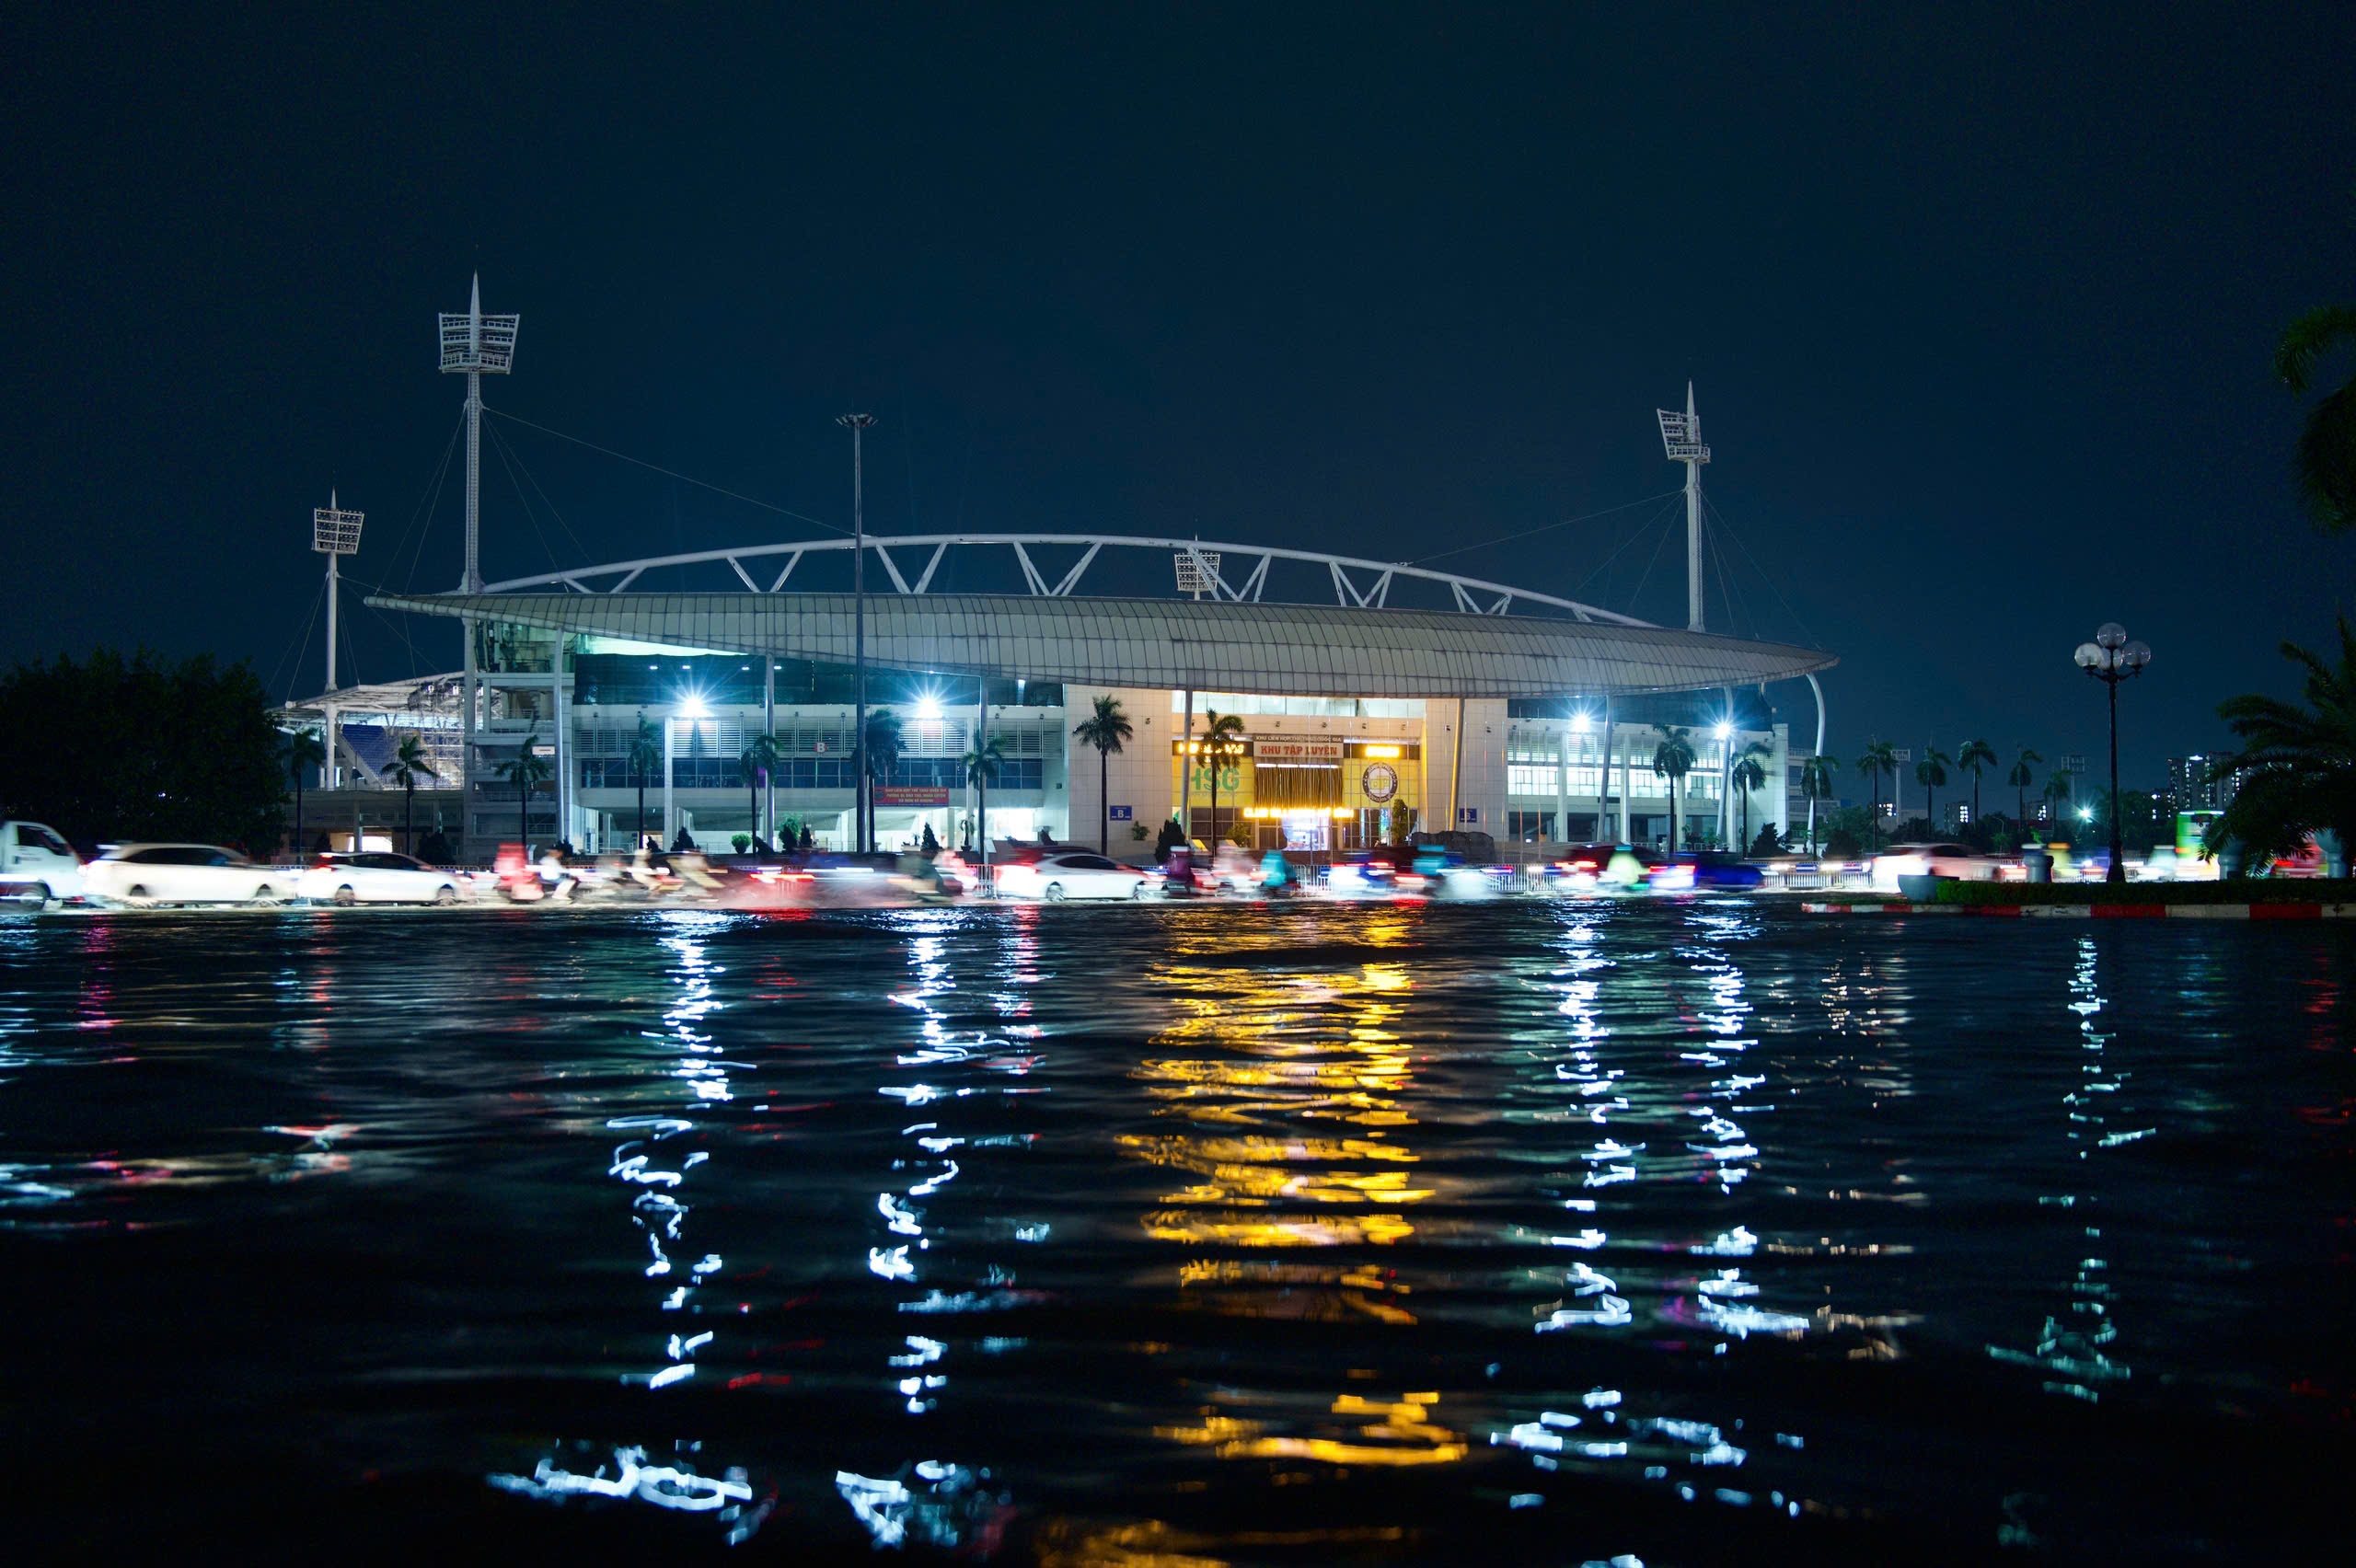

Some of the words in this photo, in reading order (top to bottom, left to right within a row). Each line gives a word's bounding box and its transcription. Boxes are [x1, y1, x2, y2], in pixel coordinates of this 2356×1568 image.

[817, 743, 826, 753] B
[1261, 745, 1281, 755] KHU
[1284, 744, 1303, 755] TẬP
[1305, 744, 1337, 756] LUYỆN
[1117, 809, 1125, 818] B
